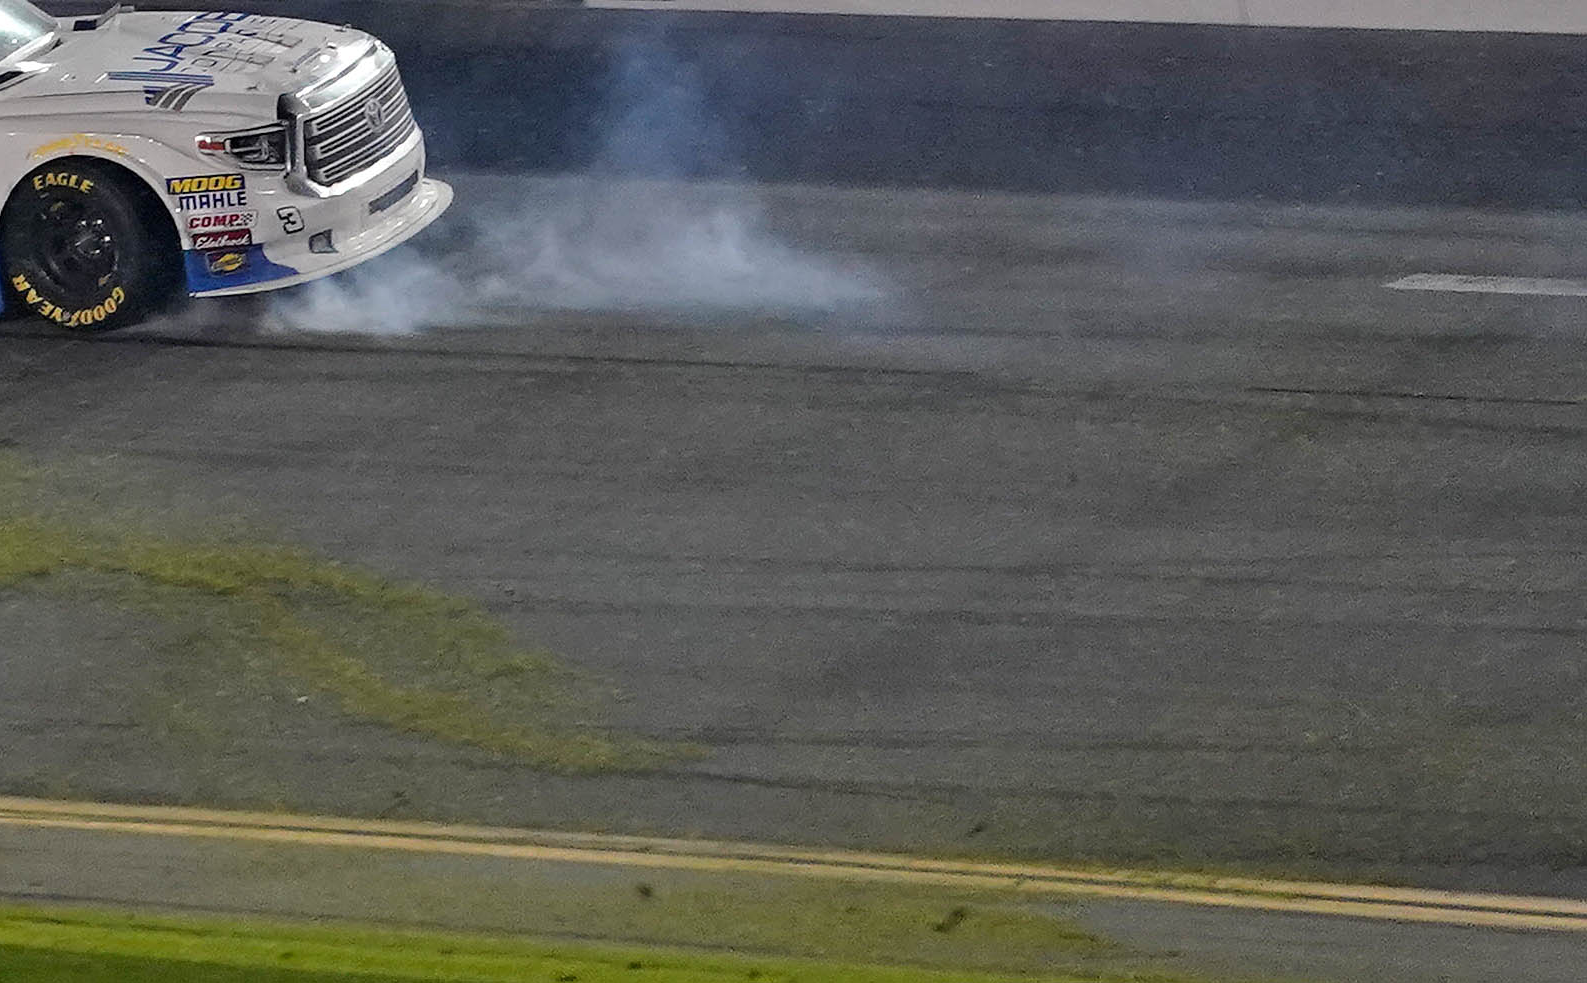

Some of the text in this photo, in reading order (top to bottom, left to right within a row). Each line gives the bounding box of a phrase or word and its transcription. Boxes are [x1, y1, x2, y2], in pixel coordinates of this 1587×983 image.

[32, 172, 94, 194] EAGLE
[170, 176, 243, 193] MOOG
[179, 191, 247, 211] MAHLE
[276, 205, 306, 235] 3
[12, 273, 126, 328] GOODYEAR
